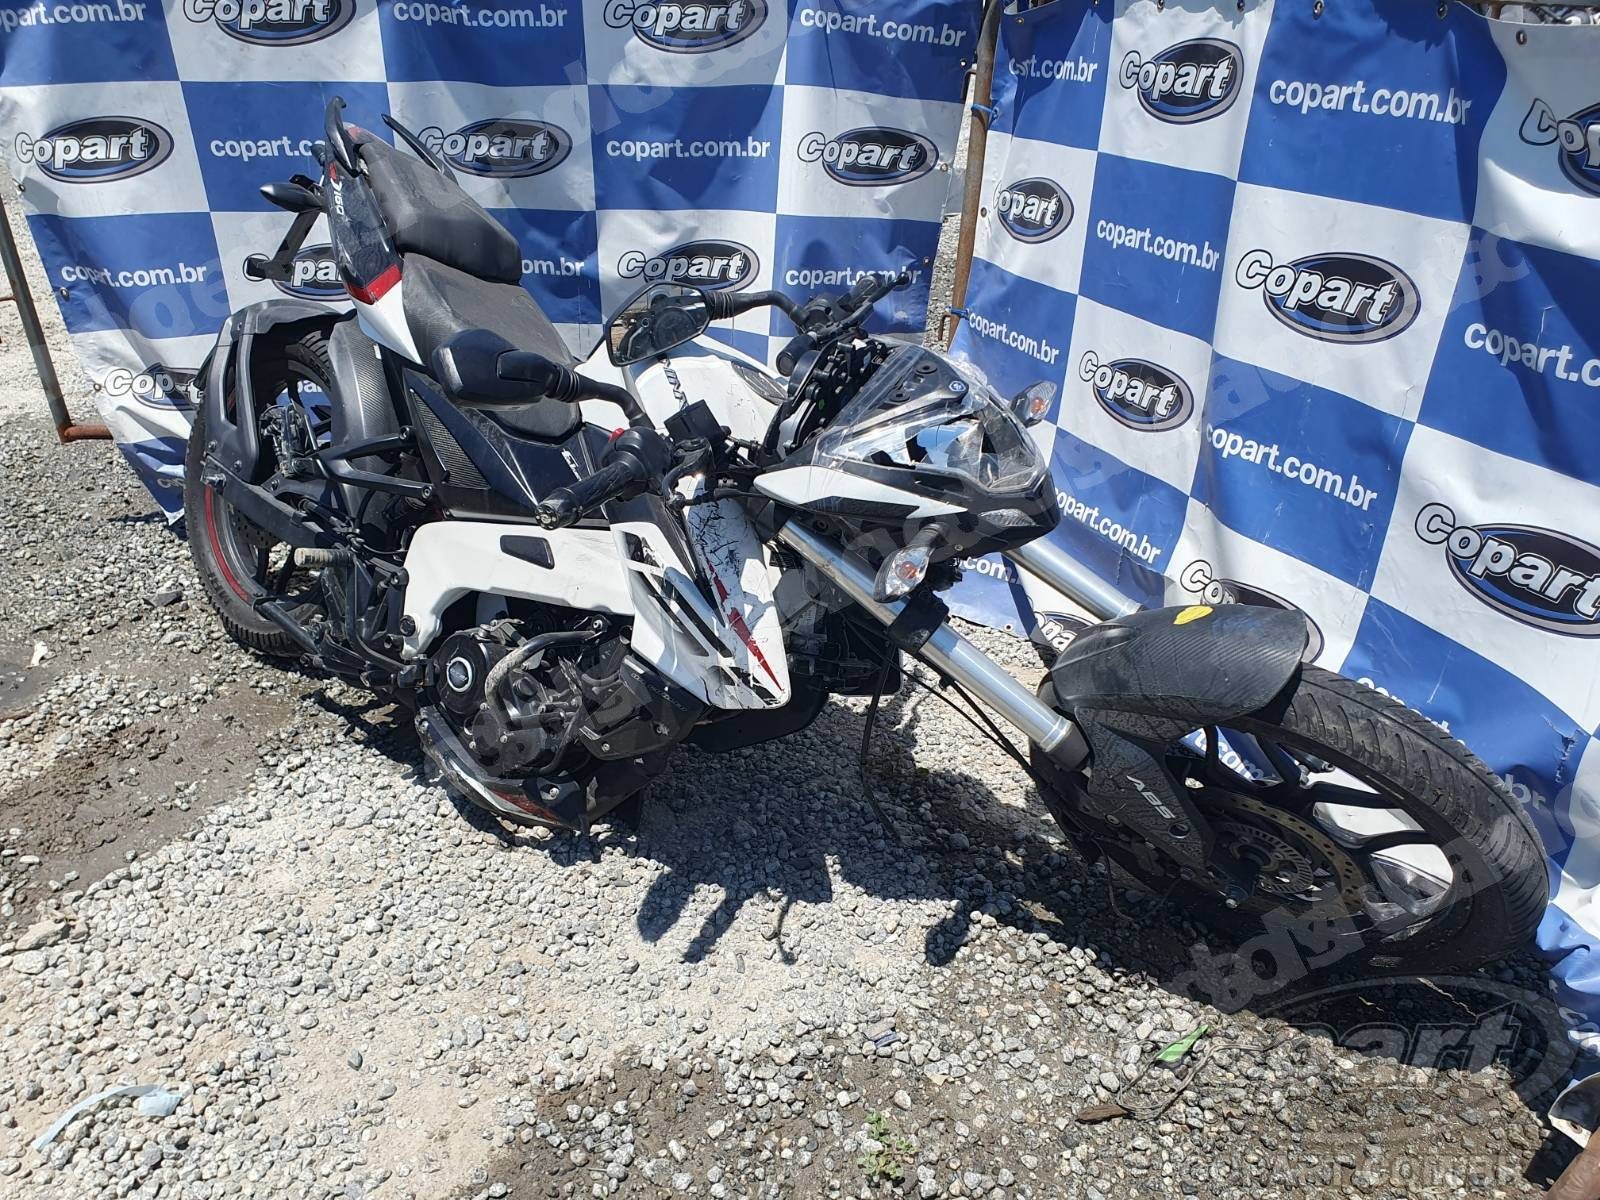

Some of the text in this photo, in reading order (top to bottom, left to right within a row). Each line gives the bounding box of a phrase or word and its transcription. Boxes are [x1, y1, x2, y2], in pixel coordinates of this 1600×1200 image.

[0, 2, 146, 32] part.com.br
[184, 0, 330, 30] Copart
[393, 1, 568, 28] copart.com.br
[604, 0, 745, 37] Copart
[799, 7, 967, 48] copart.com.br
[1118, 51, 1235, 102] Copart
[1269, 78, 1471, 126] copart.com.br
[15, 127, 150, 169] Copart
[210, 136, 326, 161] copart.c
[416, 126, 551, 162] Copart
[606, 136, 771, 161] copart.com.br
[797, 131, 922, 172] Copart
[993, 182, 1060, 228] opart
[617, 250, 746, 283] Copart
[1096, 218, 1219, 272] copart.com.br
[1236, 248, 1398, 326] Copart
[968, 312, 1060, 365] copart.com.br
[1464, 322, 1600, 388] copart.c
[1079, 350, 1179, 418] Copart
[1206, 422, 1378, 511] copart.com.br
[1055, 487, 1161, 565] opart.com.br
[1415, 502, 1600, 621] Copart
[1126, 775, 1176, 819] ABS
